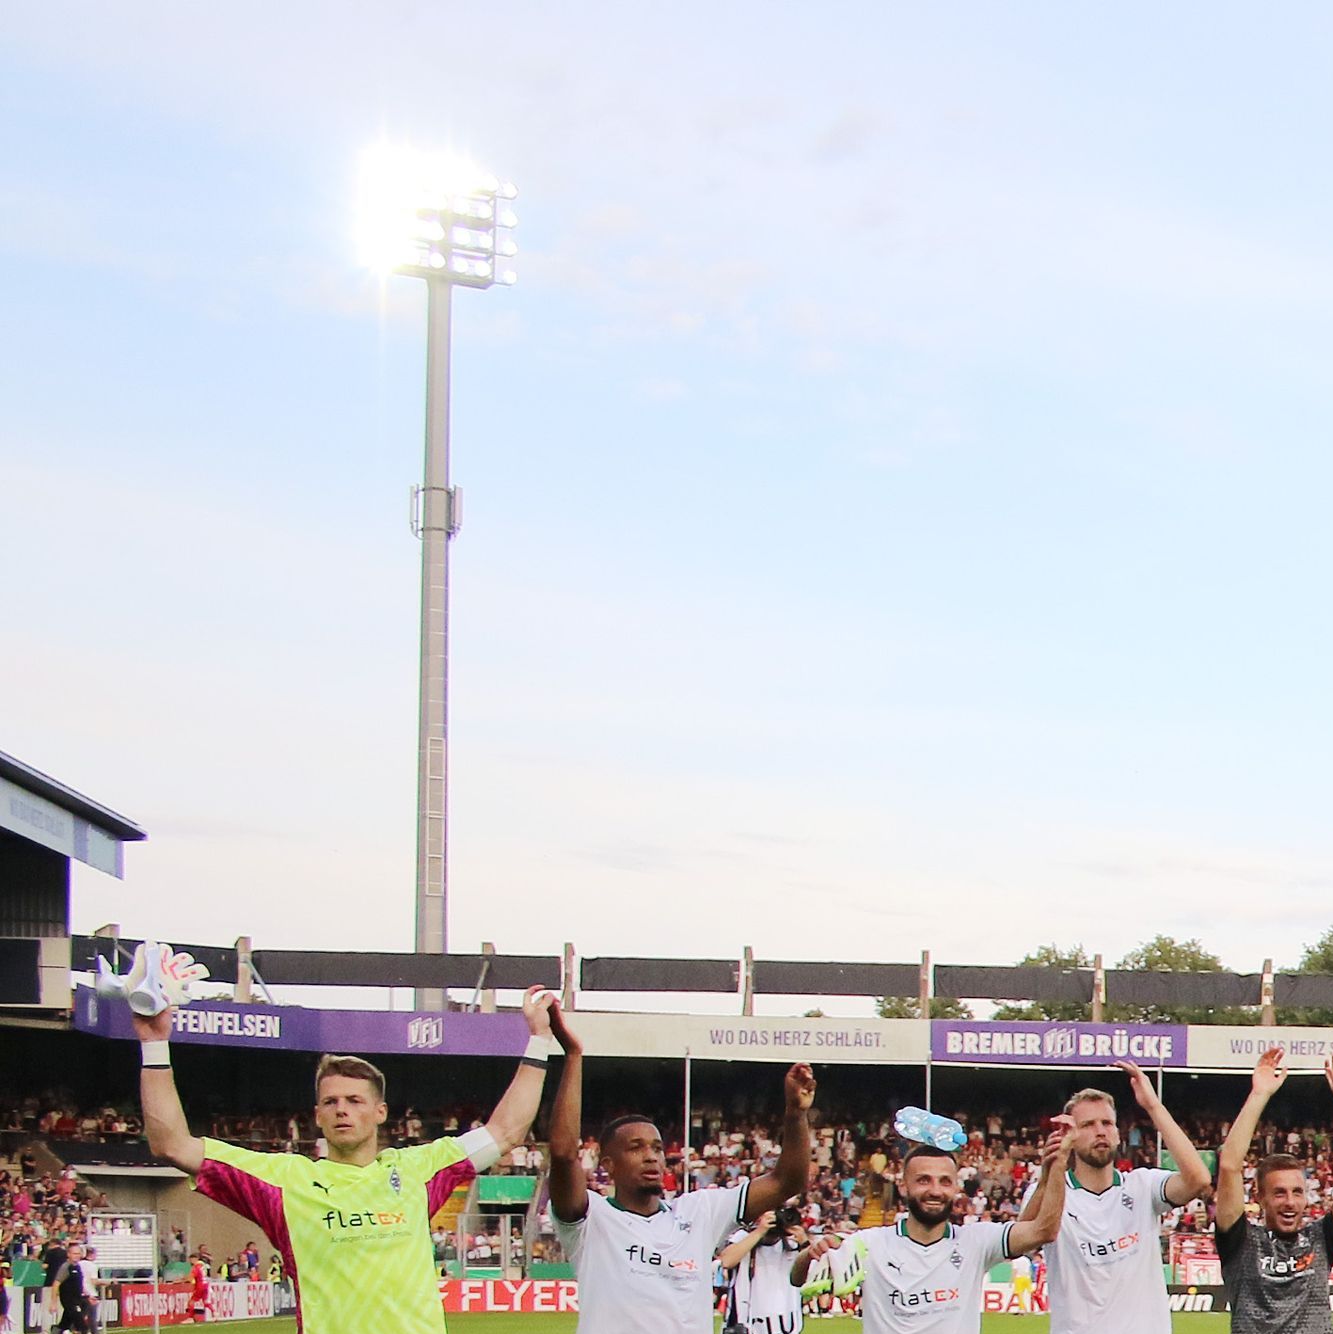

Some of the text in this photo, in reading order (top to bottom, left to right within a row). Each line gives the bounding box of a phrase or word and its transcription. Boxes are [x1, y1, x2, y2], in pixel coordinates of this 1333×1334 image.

[710, 1028, 886, 1048] WO DAS HERZ SCHLÄGT.
[946, 1031, 1041, 1056] BREMER
[1079, 1030, 1172, 1058] BRÜCKE
[1230, 1039, 1253, 1054] WO
[1258, 1039, 1286, 1053] DAS
[1290, 1041, 1325, 1056] HERZ
[134, 1292, 168, 1317] STRASS
[248, 1284, 270, 1317] ERGO
[461, 1280, 580, 1312] FLYER
